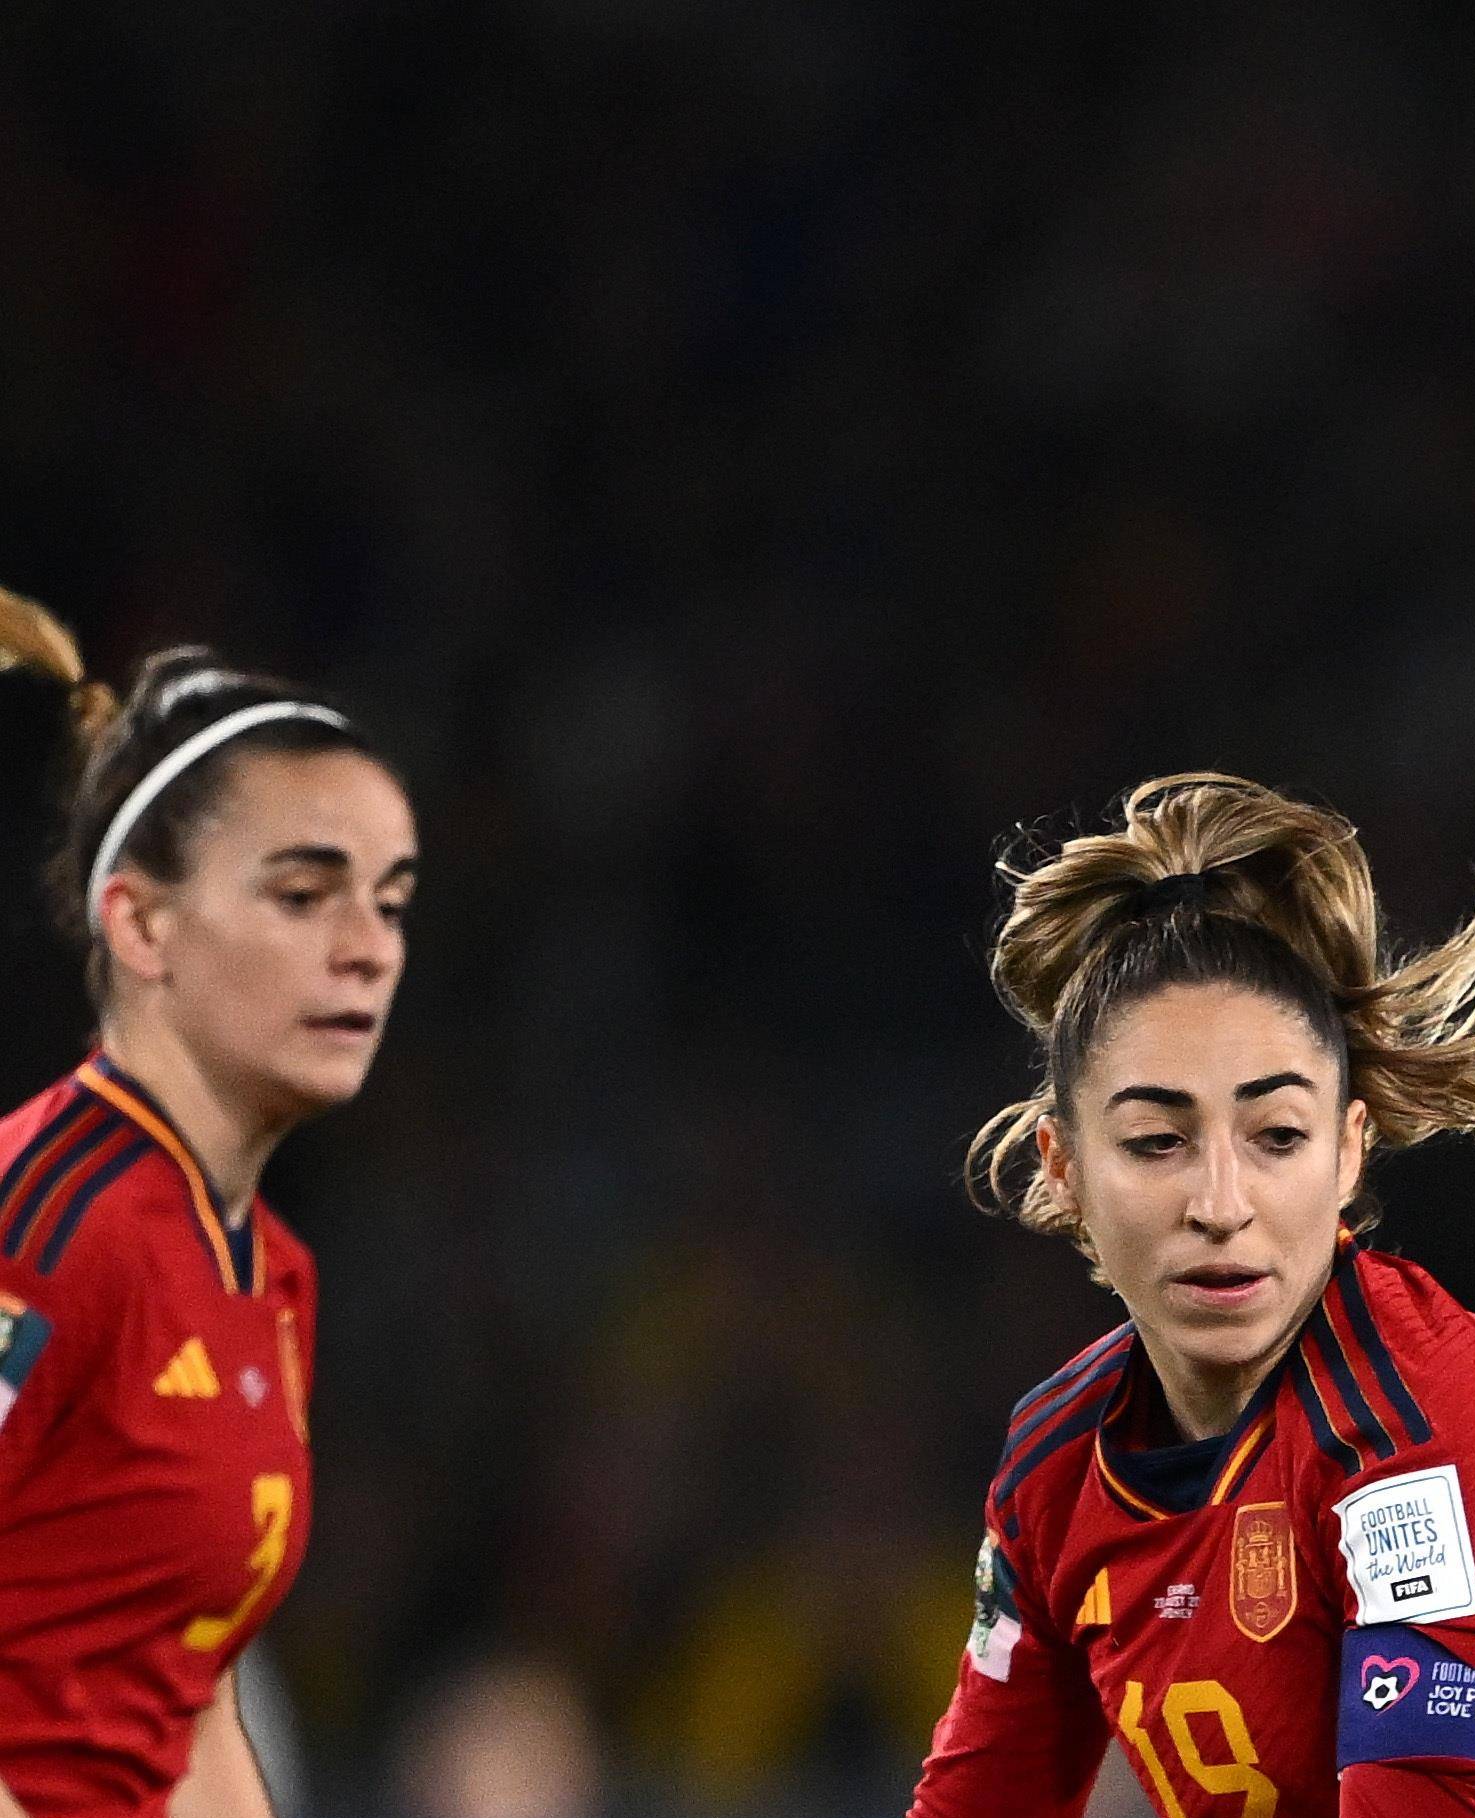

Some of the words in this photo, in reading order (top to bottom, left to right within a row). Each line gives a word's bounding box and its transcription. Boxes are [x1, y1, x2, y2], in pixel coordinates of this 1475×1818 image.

[1360, 1498, 1432, 1531] FOOTBALL
[1366, 1518, 1438, 1556] UNITES
[1366, 1558, 1393, 1581] the
[1396, 1544, 1446, 1574] World
[1395, 1580, 1429, 1597] FIFA
[1429, 1685, 1463, 1700] JOY
[1427, 1700, 1471, 1718] LOVE
